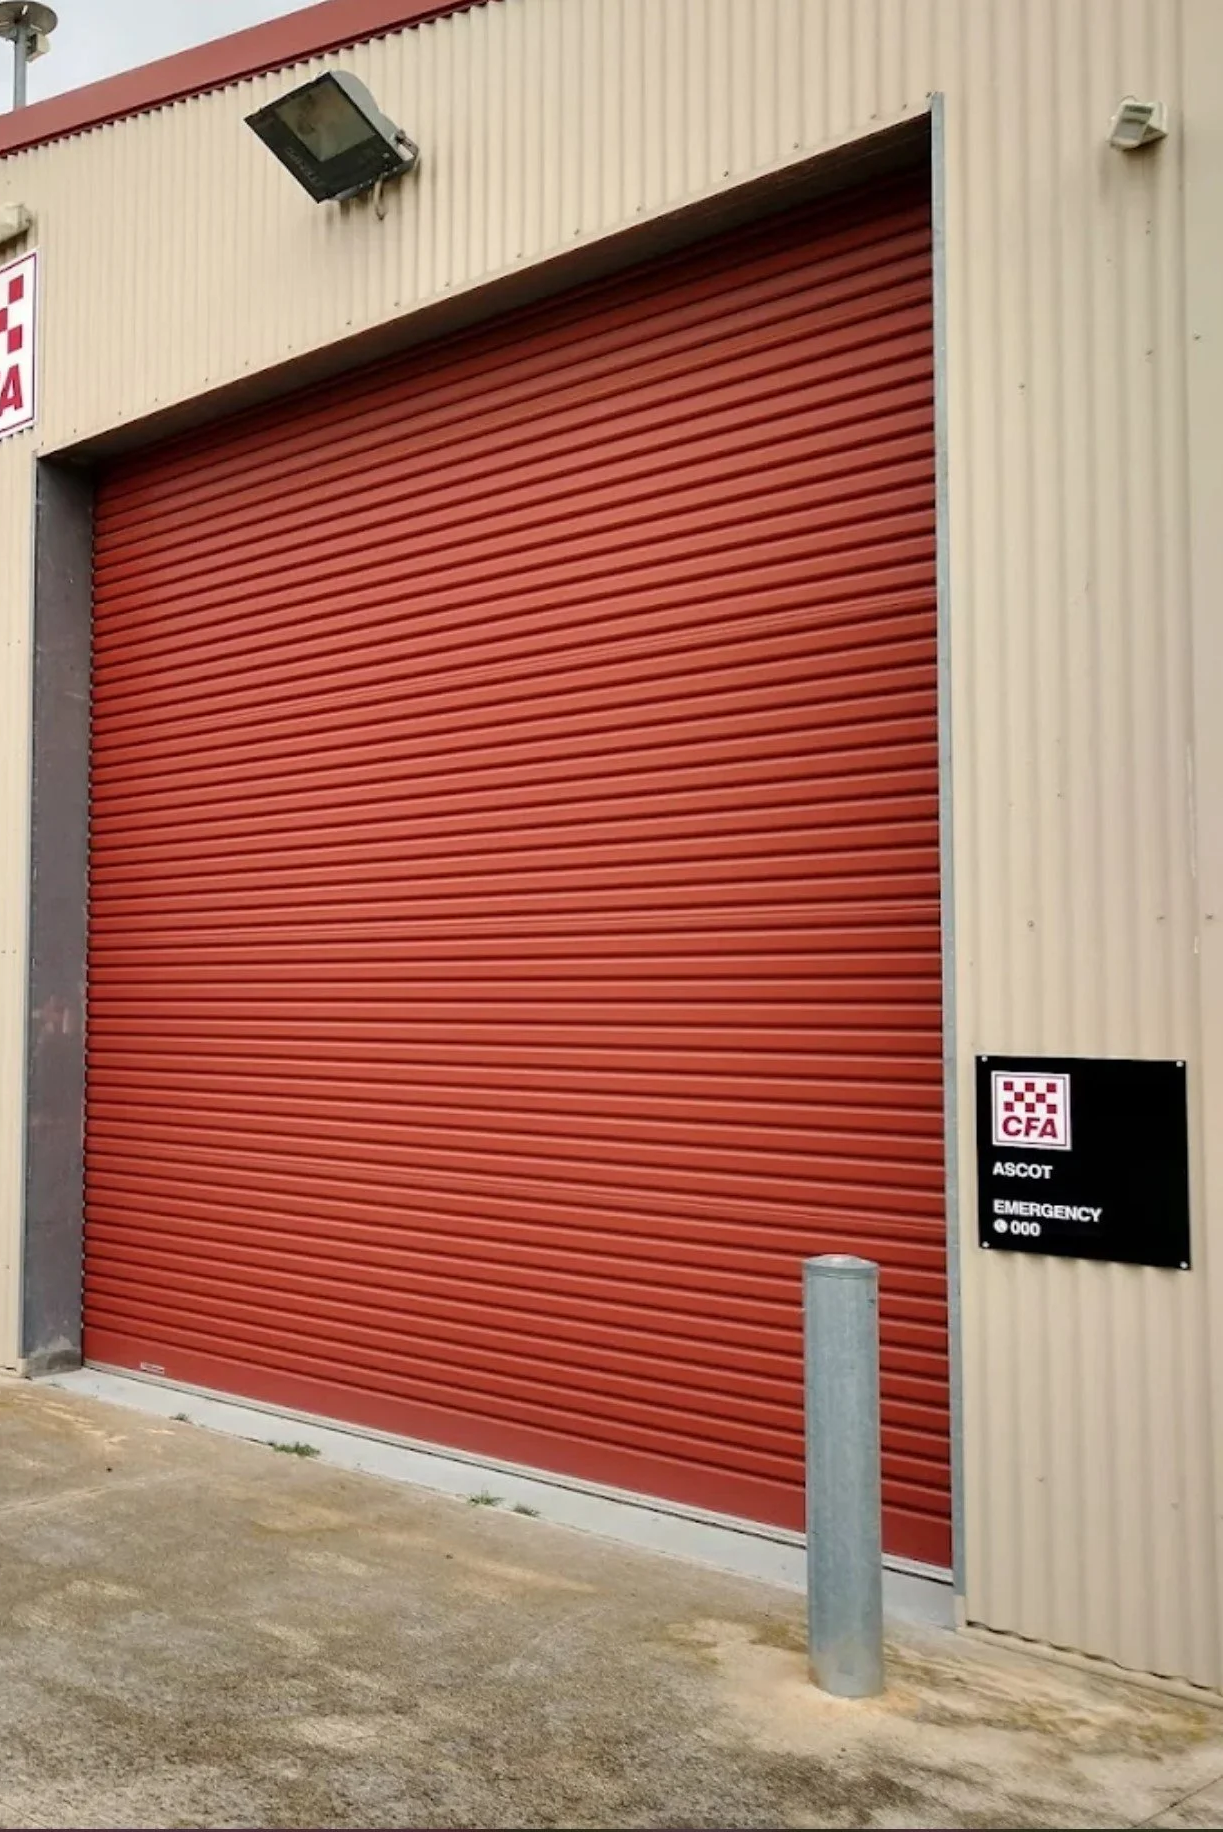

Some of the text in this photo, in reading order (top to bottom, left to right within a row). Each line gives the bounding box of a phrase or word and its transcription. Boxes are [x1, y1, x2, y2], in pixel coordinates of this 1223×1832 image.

[1002, 1115, 1058, 1139] CFA
[992, 1161, 1053, 1179] ASCOT
[993, 1199, 1102, 1222] EMERGENCY
[1010, 1221, 1041, 1237] 000
